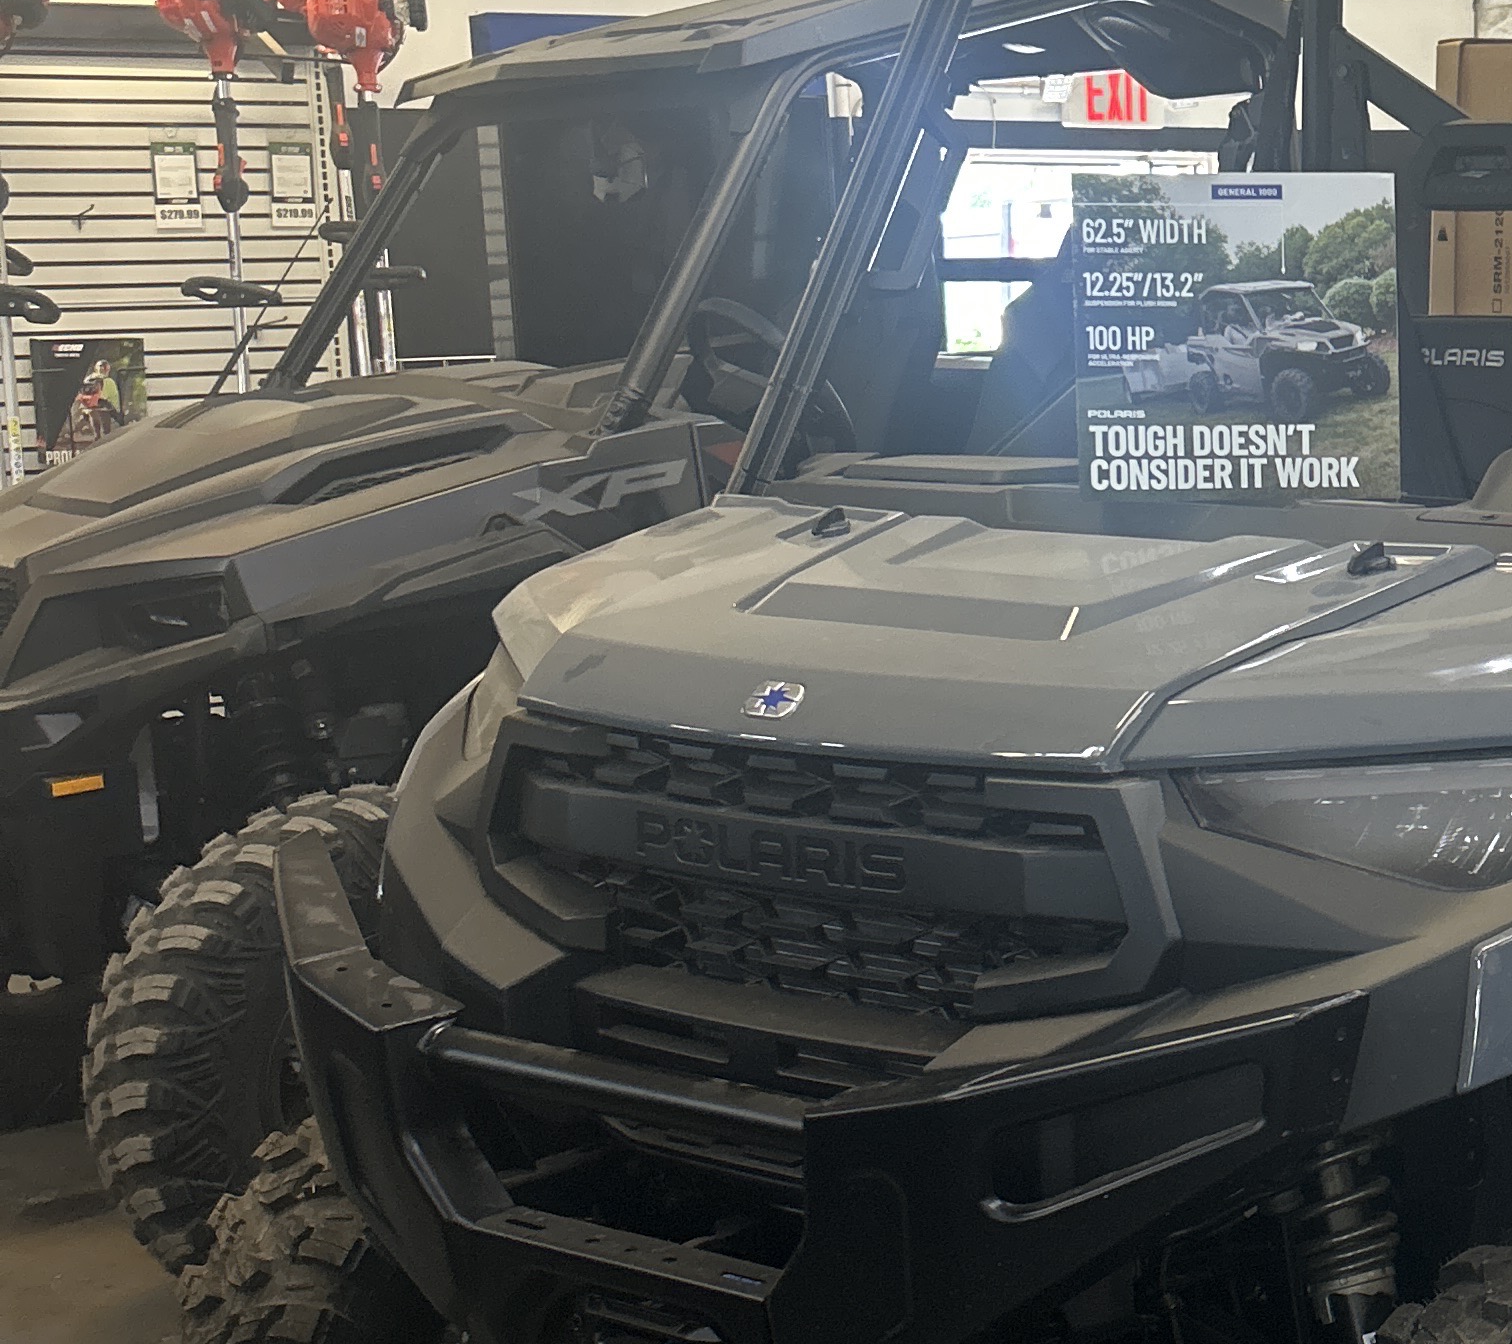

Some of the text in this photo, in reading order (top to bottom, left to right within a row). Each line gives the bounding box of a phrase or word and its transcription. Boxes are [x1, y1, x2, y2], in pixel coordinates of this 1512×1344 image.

[1218, 188, 1257, 196] GENERAL
[1082, 218, 1207, 244] 62.5" WIDTH
[1086, 326, 1155, 350] 100 HP
[1421, 348, 1505, 367] LARIS
[1088, 410, 1146, 418] POLARIS
[1089, 424, 1316, 457] TOUGH DOESN'T
[1090, 457, 1360, 490] CONSIDER IT WORK
[512, 459, 687, 520] XP
[635, 810, 906, 893] POLARIS
